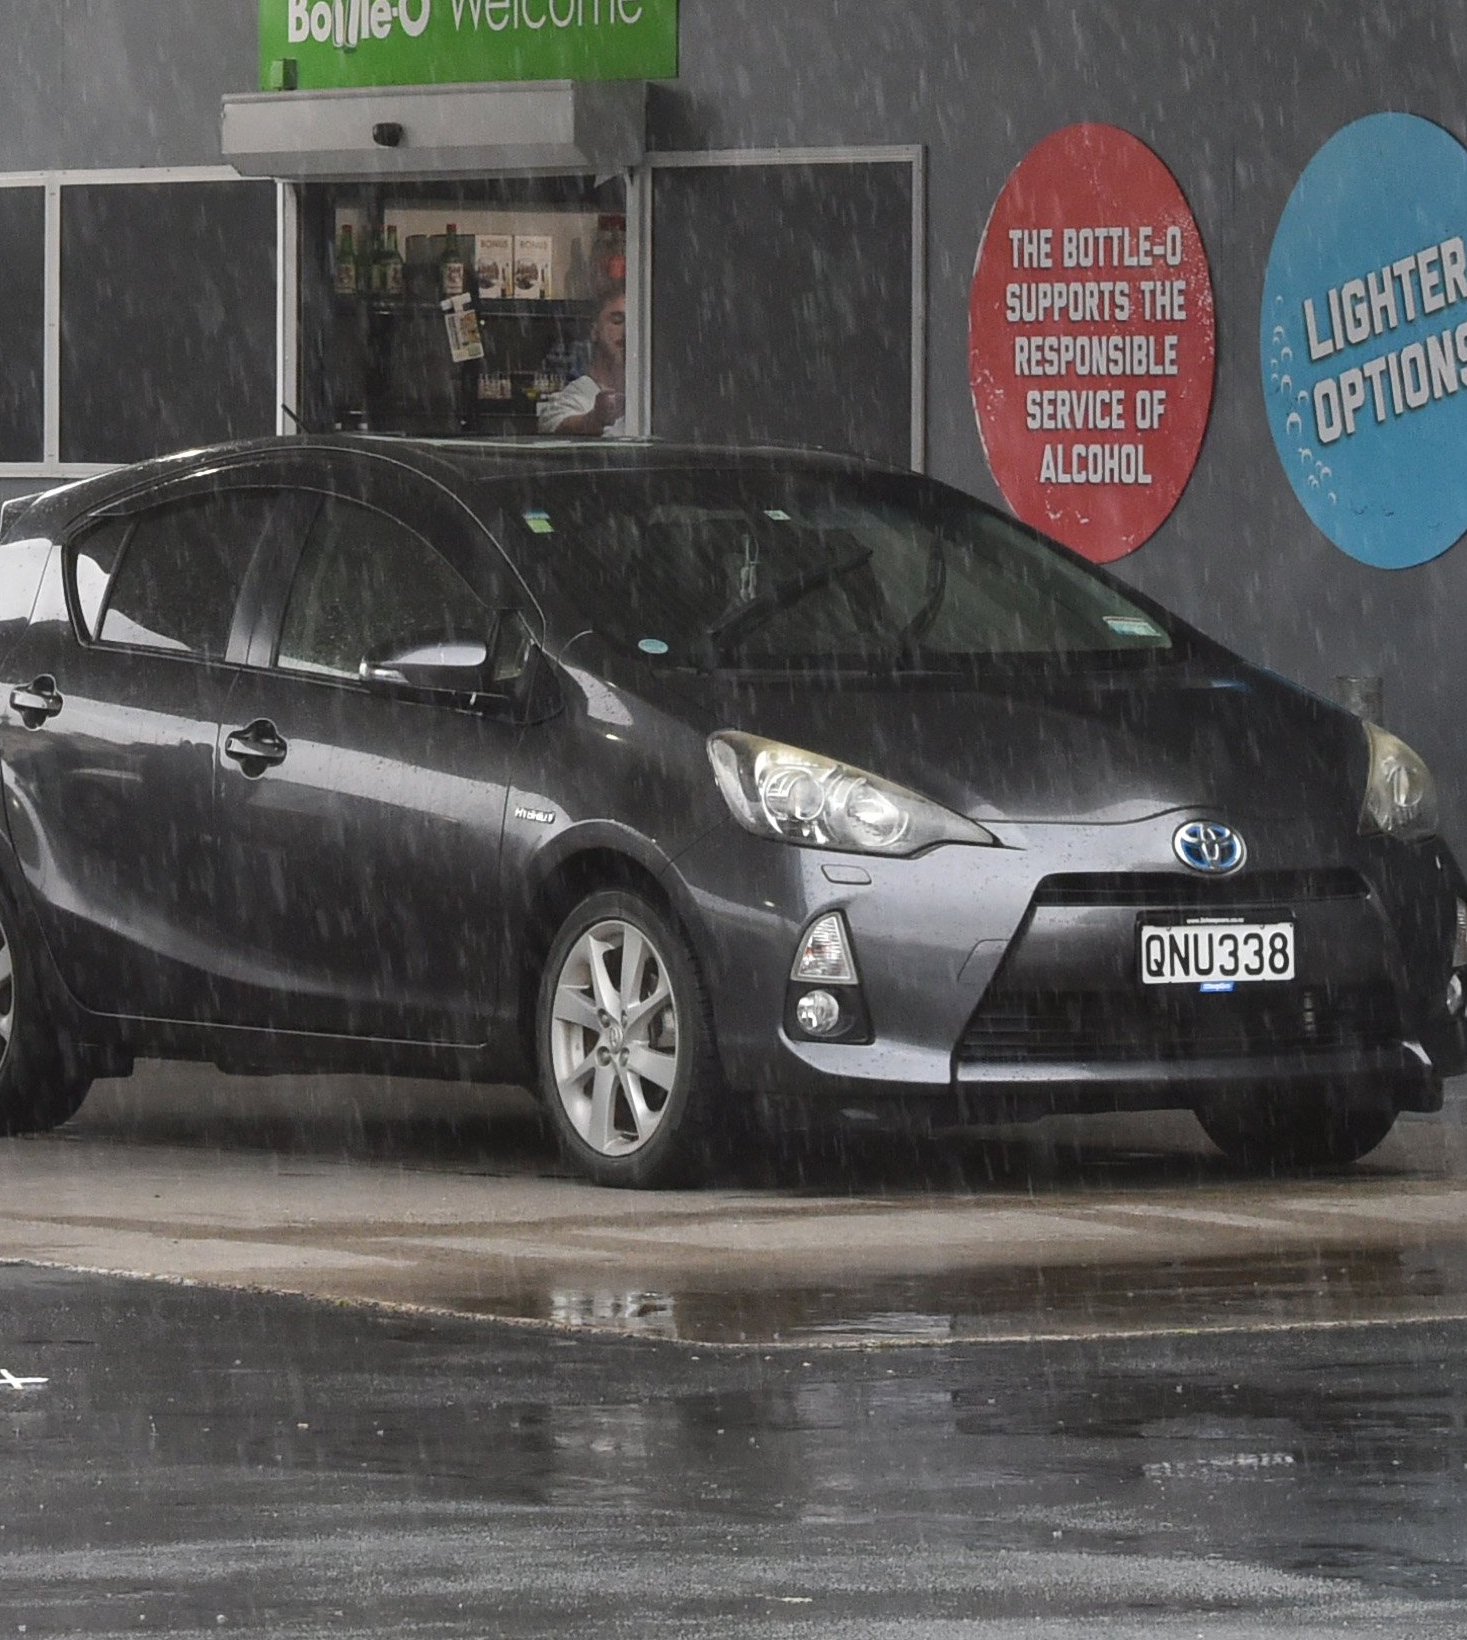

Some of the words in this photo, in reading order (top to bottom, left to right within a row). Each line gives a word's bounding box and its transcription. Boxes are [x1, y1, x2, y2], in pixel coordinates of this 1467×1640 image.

[1008, 228, 1054, 269] THE
[1061, 224, 1183, 269] BOTTLE-O
[1005, 280, 1131, 323] SUPPORTS
[1140, 278, 1187, 321] THE
[1013, 334, 1179, 377] RESPONSIBLE
[1026, 389, 1126, 431] SERVICE
[1135, 388, 1167, 430] OF
[1039, 442, 1153, 485] ALCOHOL
[1145, 932, 1290, 978] QNU338
